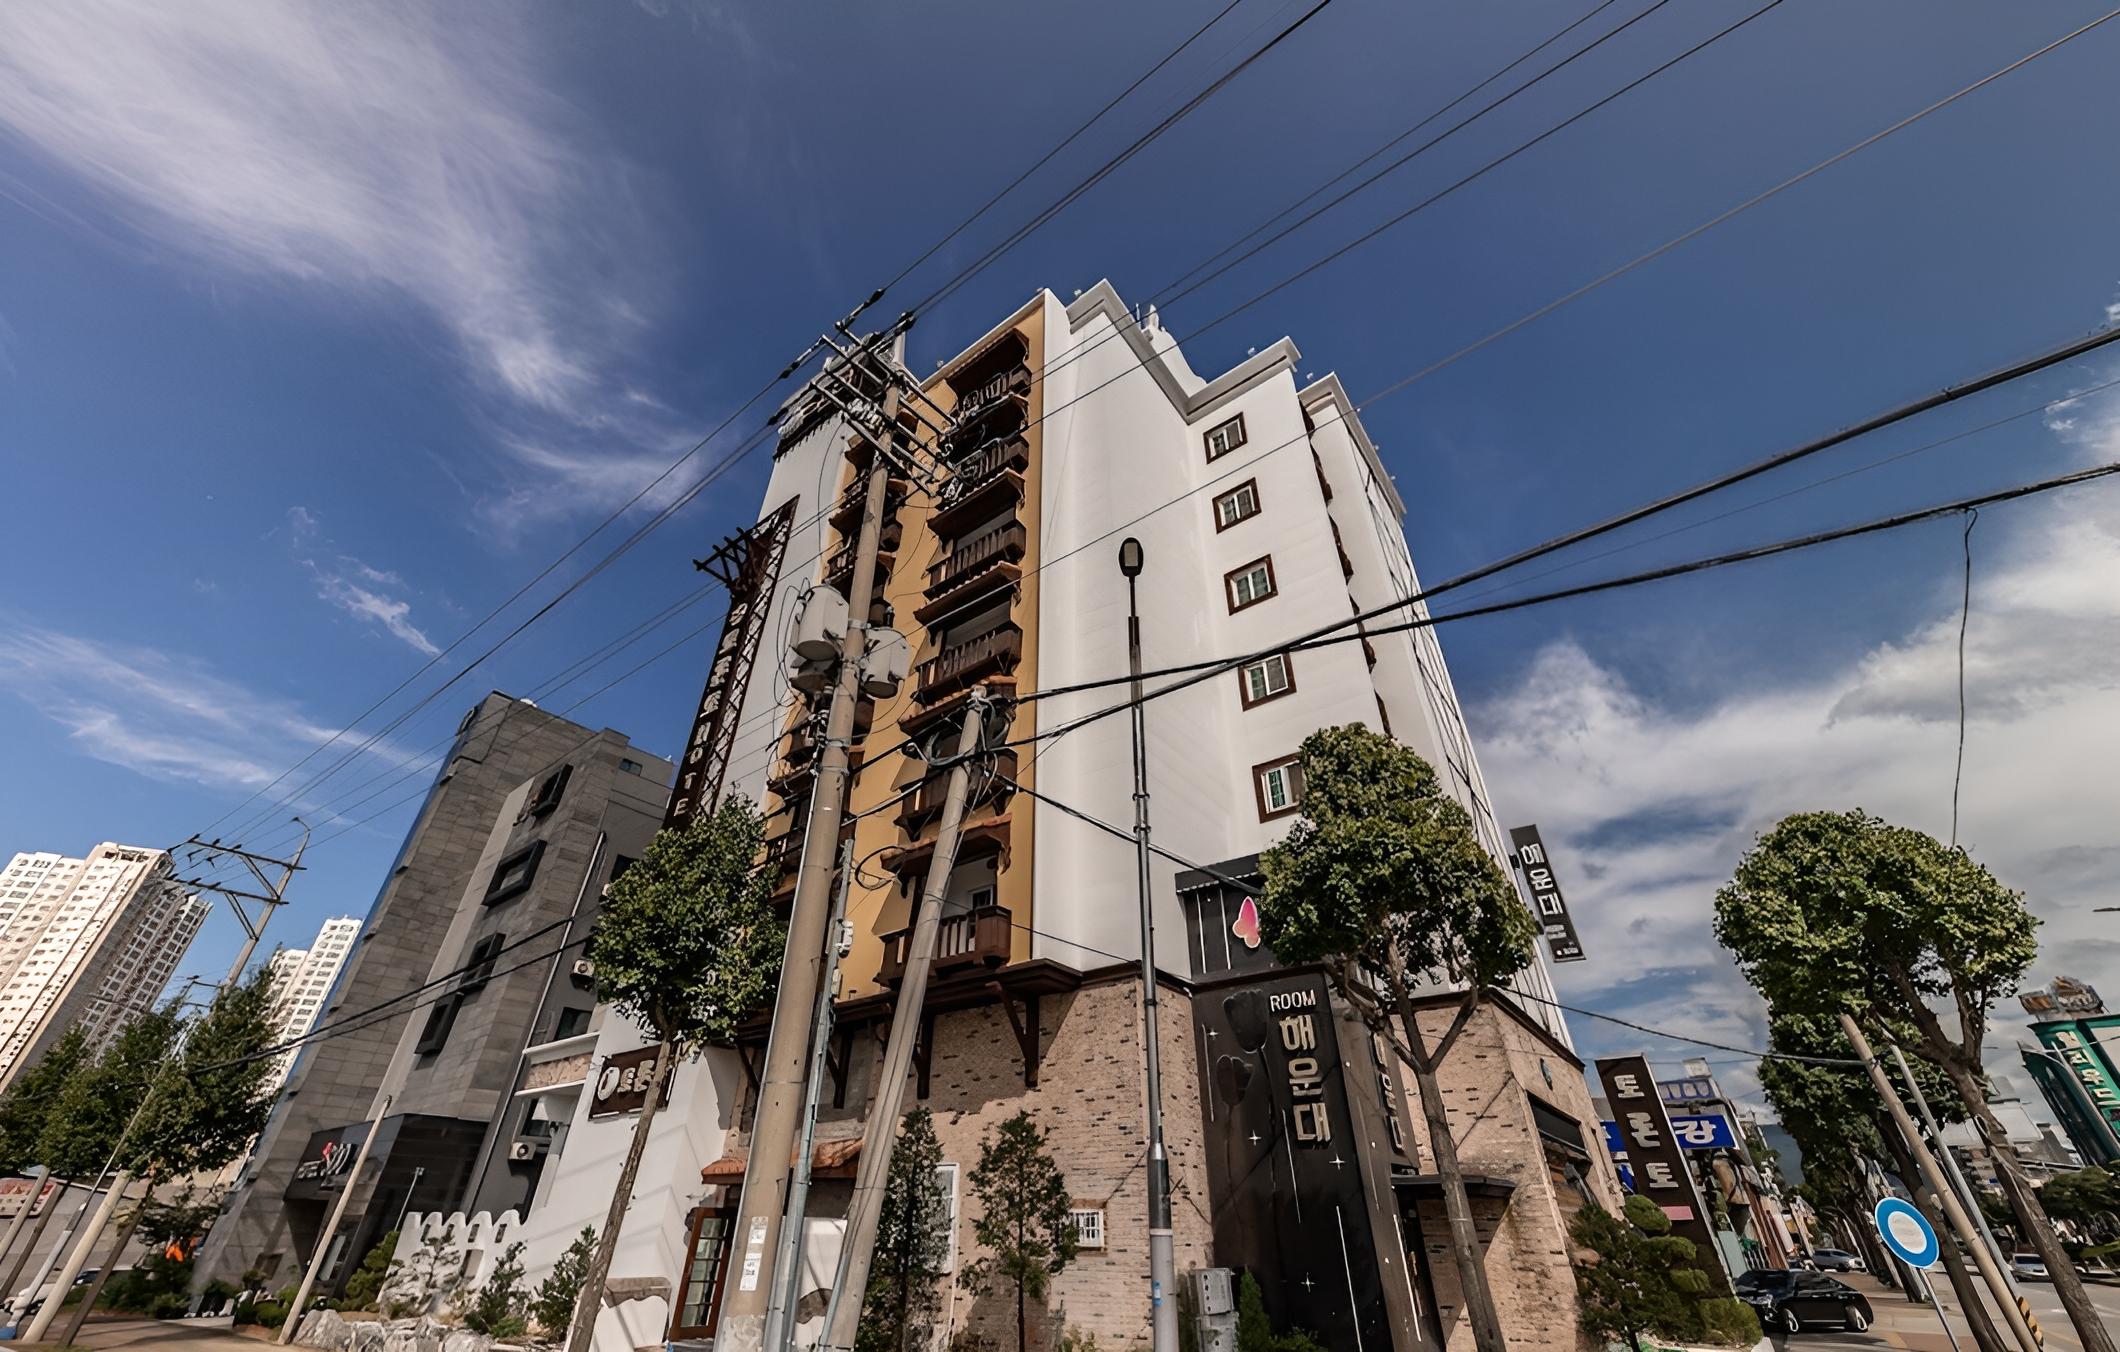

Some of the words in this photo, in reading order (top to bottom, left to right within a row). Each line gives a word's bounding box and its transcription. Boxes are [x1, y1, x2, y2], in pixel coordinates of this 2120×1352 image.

[673, 721, 711, 816] HOTE
[1269, 989, 1316, 1012] ROOM
[1279, 1014, 1331, 1142] 해운대
[1613, 1074, 1679, 1188] 토론토
